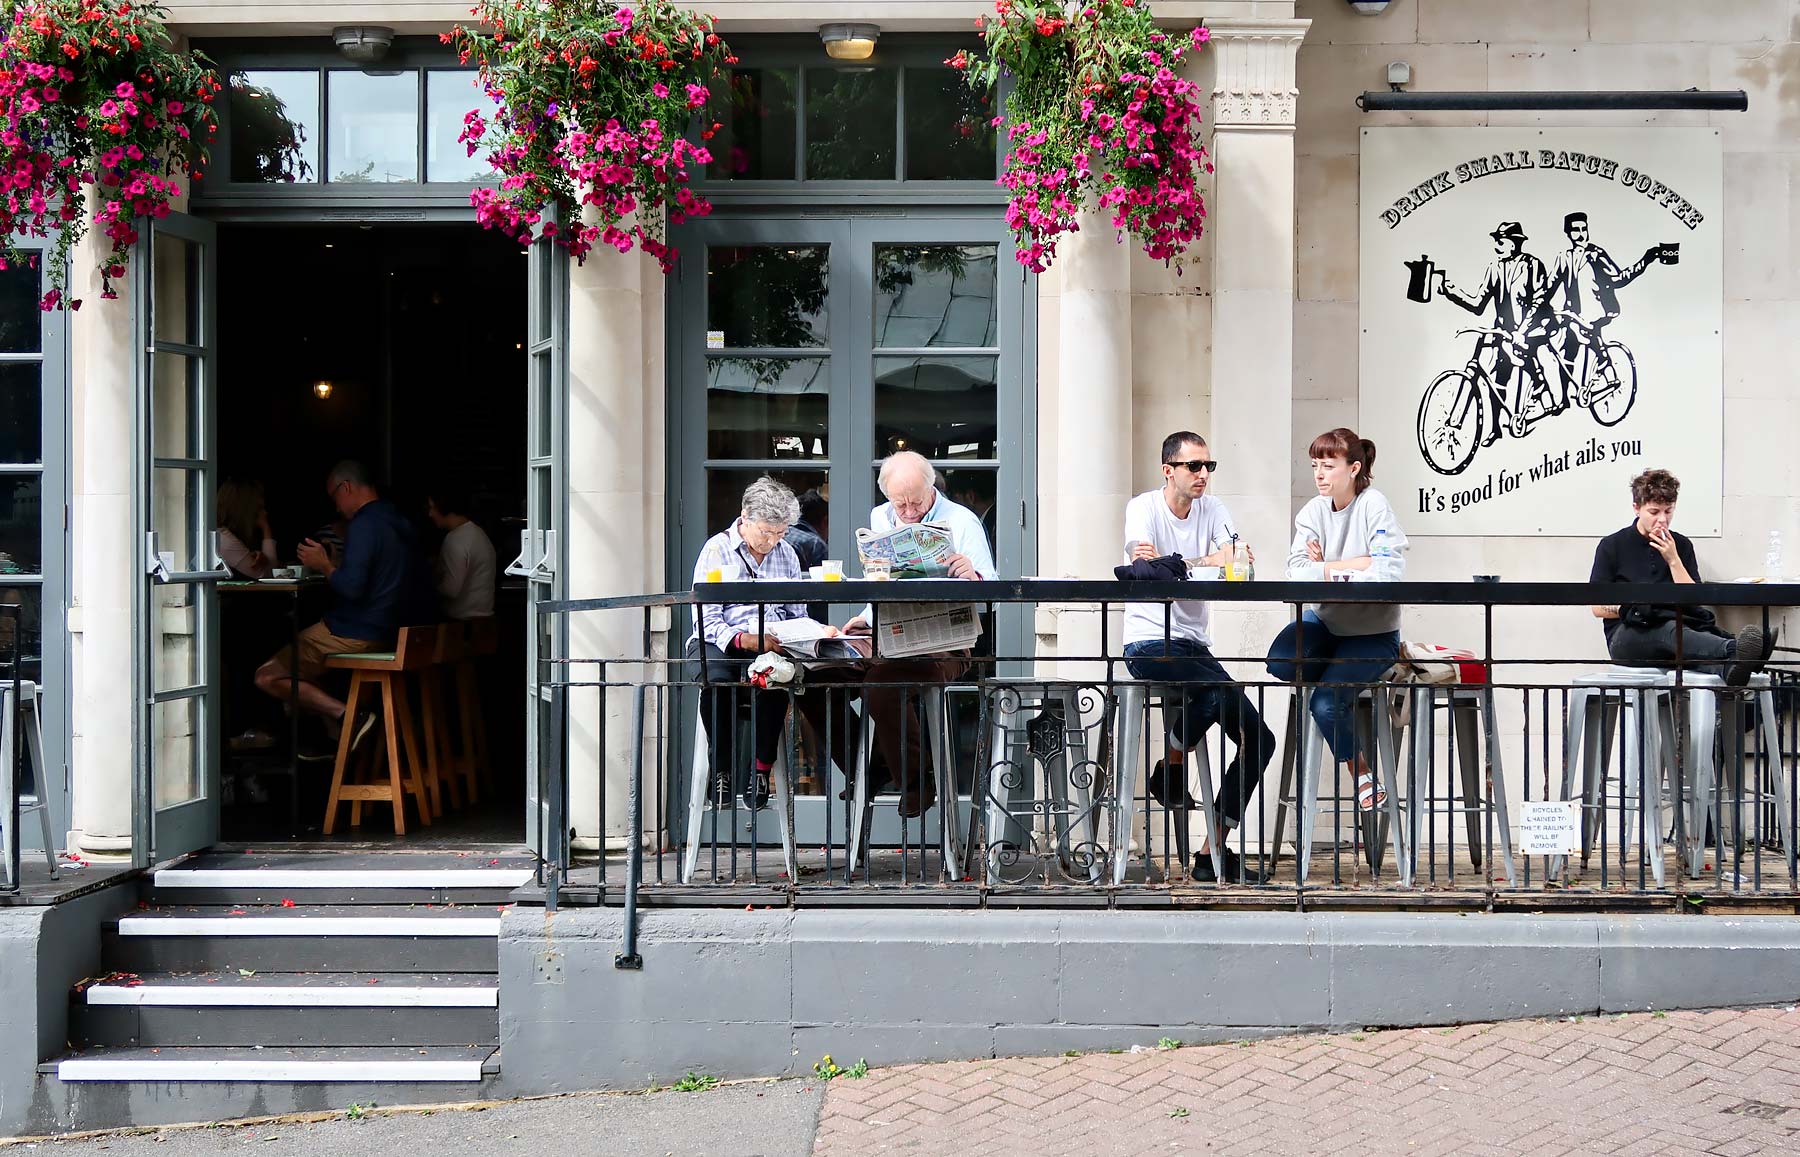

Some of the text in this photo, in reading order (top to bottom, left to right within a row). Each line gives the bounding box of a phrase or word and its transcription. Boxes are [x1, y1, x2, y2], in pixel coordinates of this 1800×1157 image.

[1379, 150, 1704, 231] DRINK SMALL BATCH COFFEE
[1418, 438, 1642, 514] It's good for what ails you
